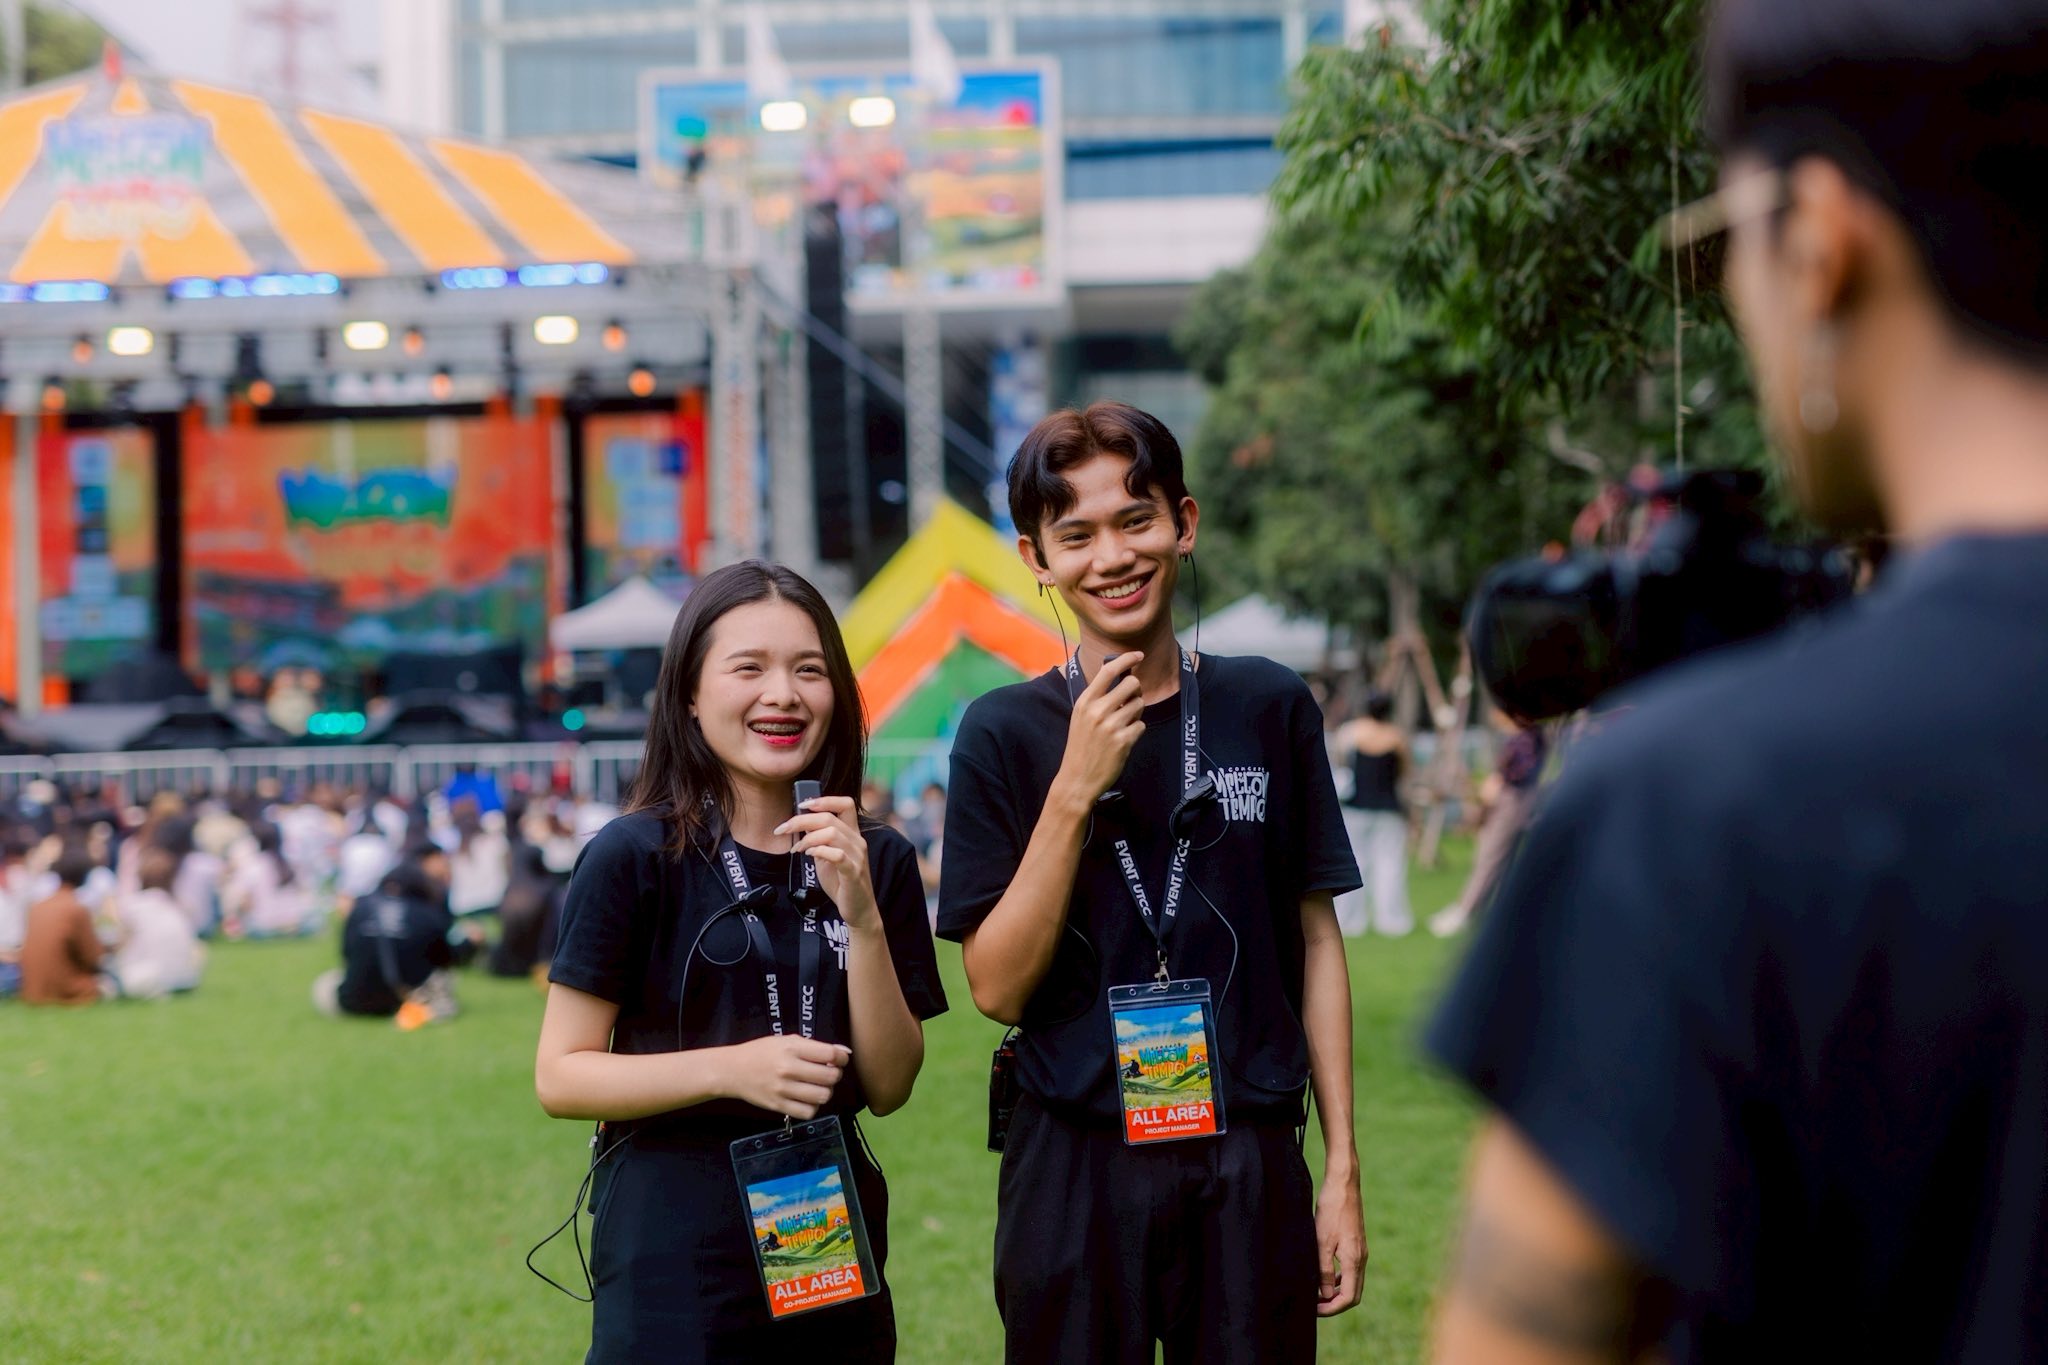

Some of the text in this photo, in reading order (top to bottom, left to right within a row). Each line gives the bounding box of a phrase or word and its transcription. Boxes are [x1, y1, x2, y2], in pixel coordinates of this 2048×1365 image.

[723, 850, 748, 888] EVENT
[1114, 839, 1153, 917] EVENT UTCC
[1165, 838, 1191, 917] EVENT UTCC
[766, 973, 780, 1019] EVENT
[802, 984, 815, 1021] UTCC
[1132, 1104, 1211, 1126] ALL AREA
[1144, 1122, 1200, 1135] PROJECT MANAGER
[775, 1268, 857, 1301] ALL AREA
[783, 1286, 853, 1309] CO-PROJECT MANAGER
